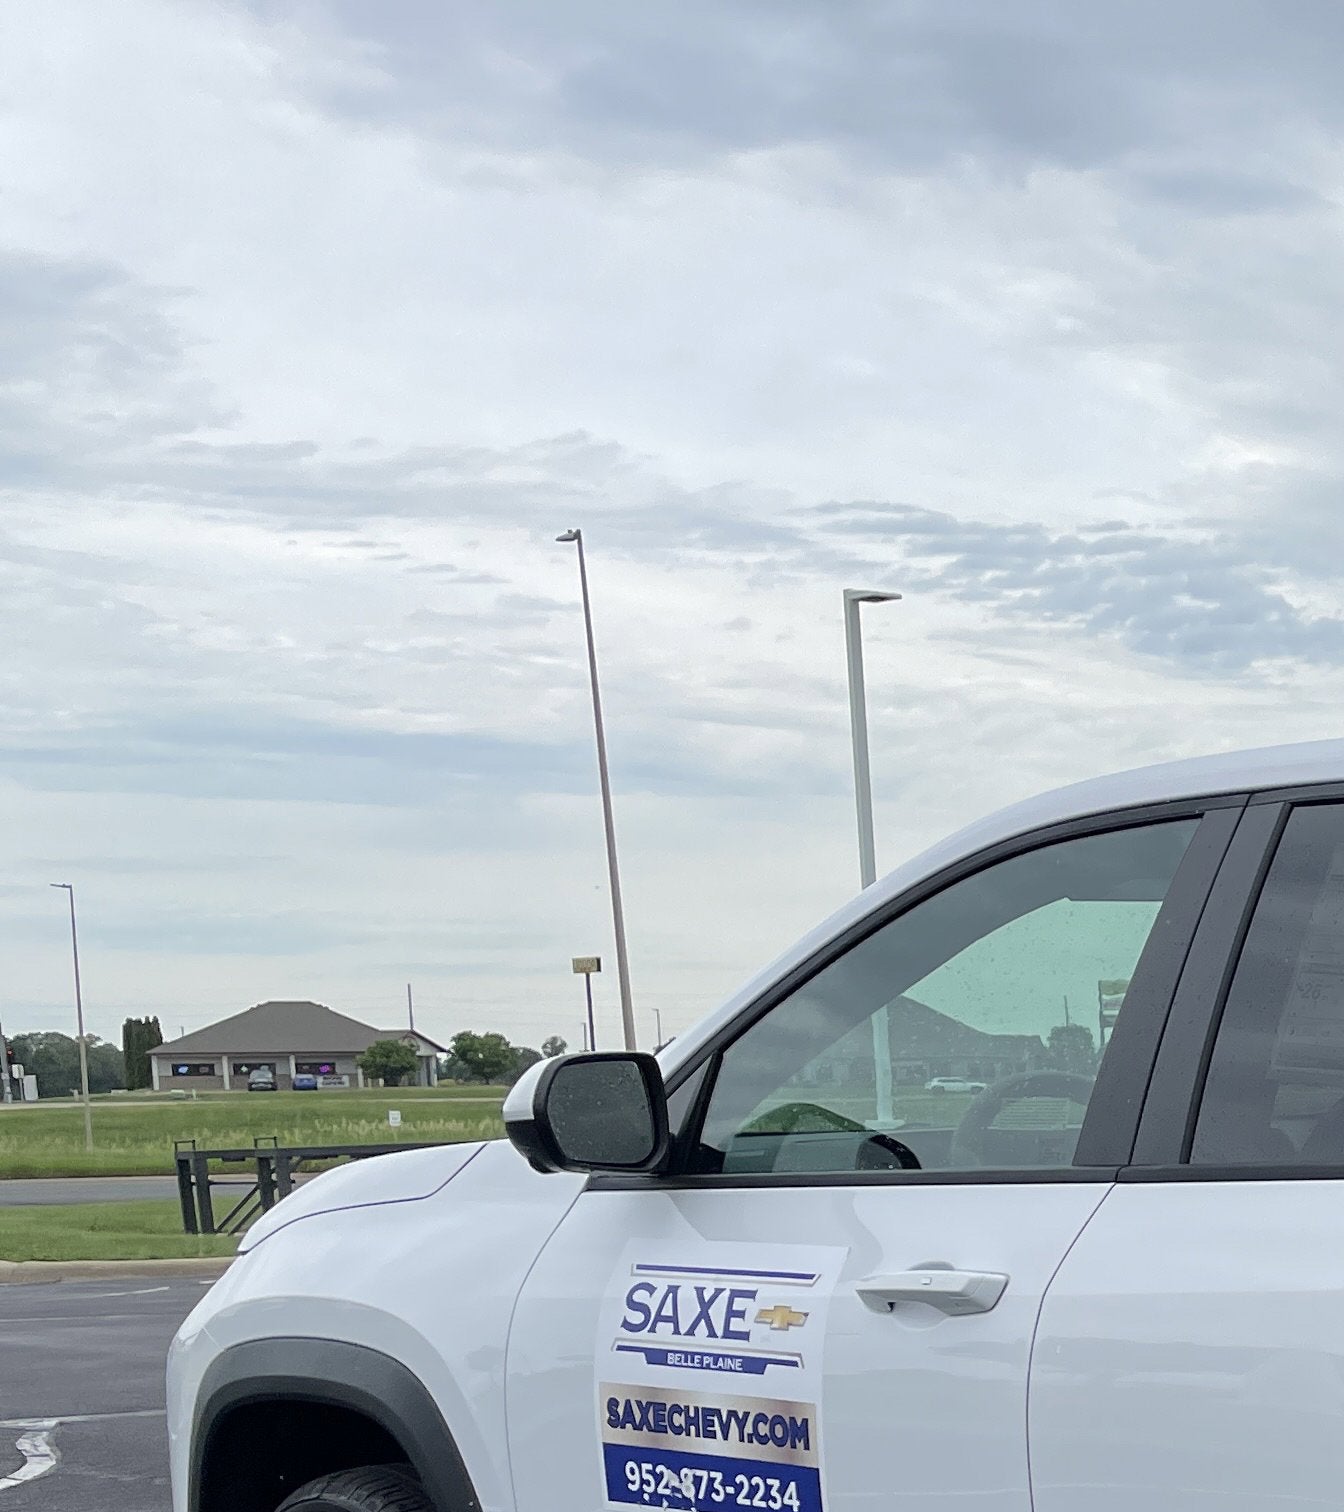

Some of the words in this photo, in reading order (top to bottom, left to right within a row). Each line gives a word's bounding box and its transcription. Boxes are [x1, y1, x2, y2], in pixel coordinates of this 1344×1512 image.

[620, 1282, 758, 1342] SAXE
[667, 1353, 701, 1368] BELLE
[703, 1355, 743, 1371] PLAINE
[606, 1397, 810, 1451] SAXECHEVY.COM
[624, 1461, 800, 1512] 952-873-2234
